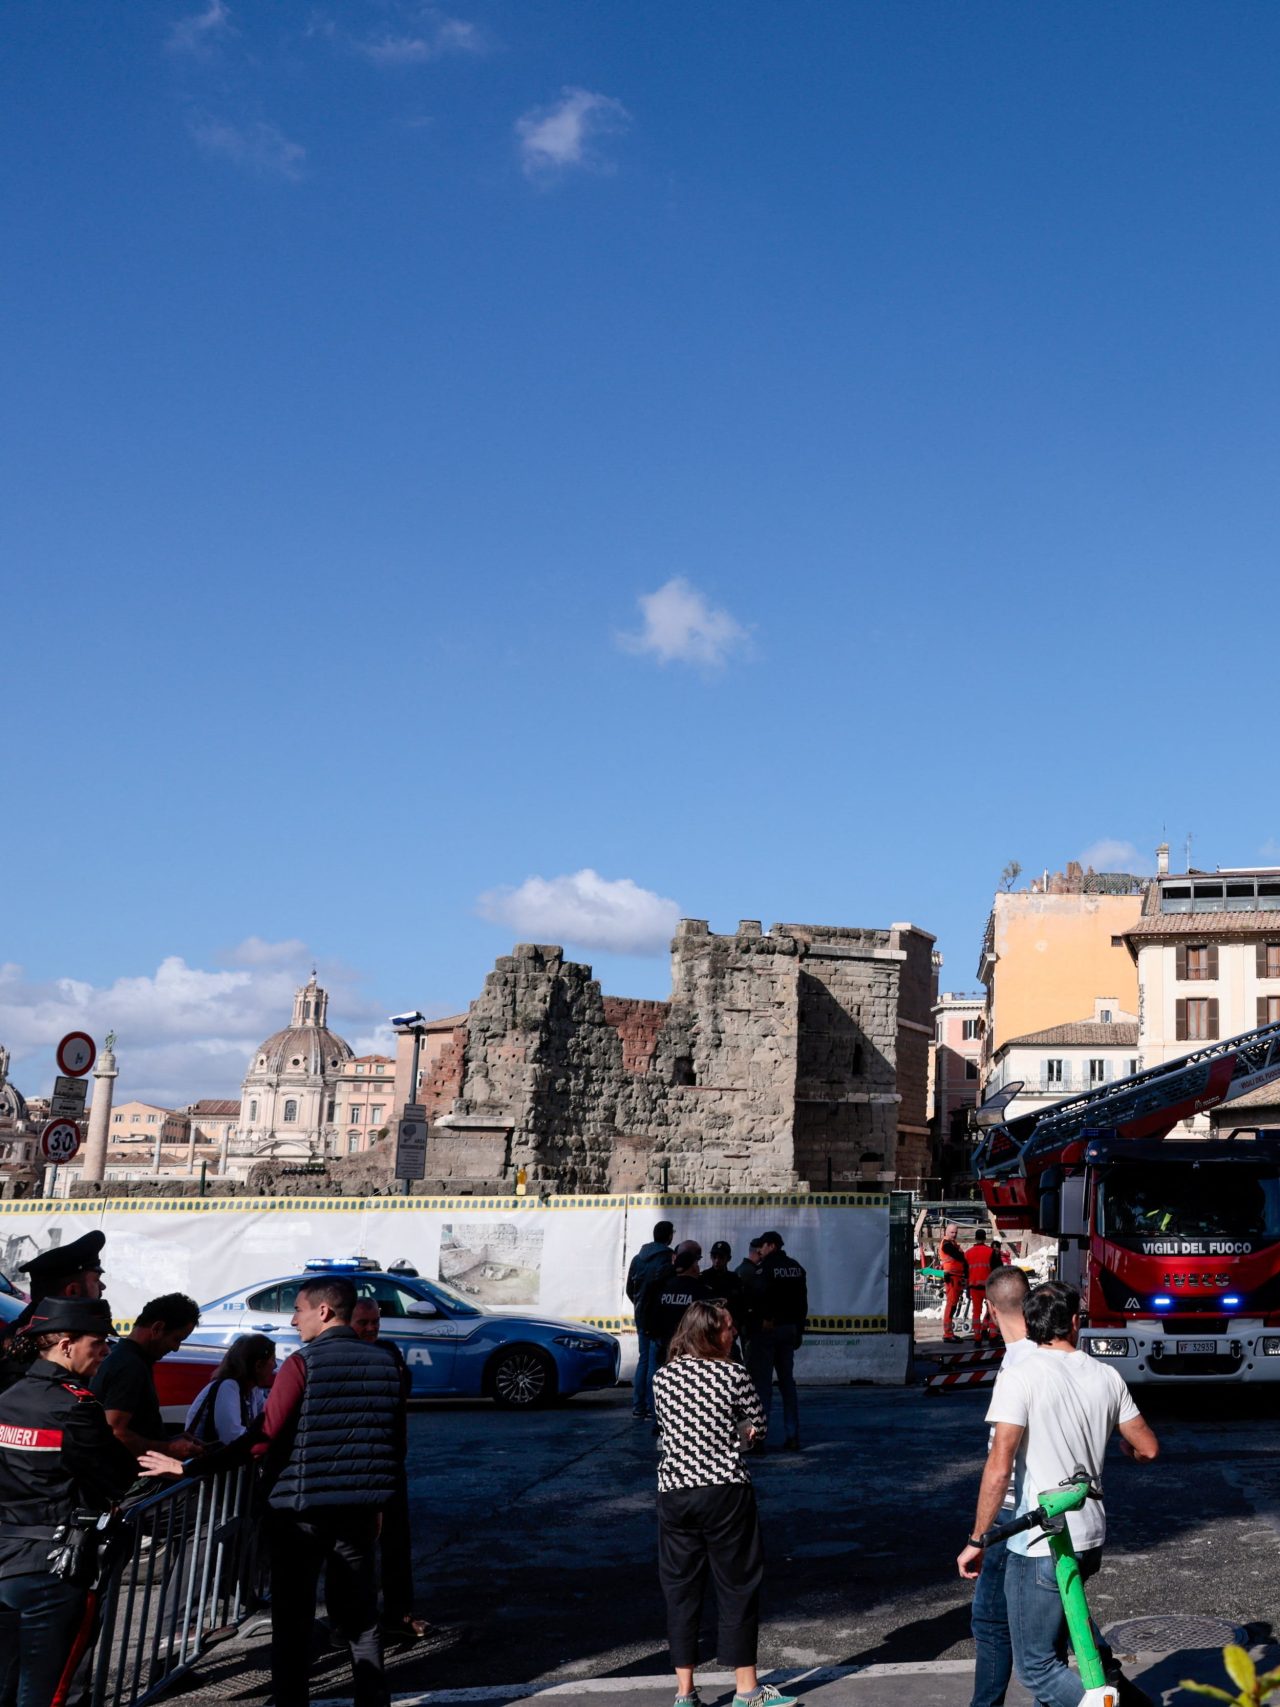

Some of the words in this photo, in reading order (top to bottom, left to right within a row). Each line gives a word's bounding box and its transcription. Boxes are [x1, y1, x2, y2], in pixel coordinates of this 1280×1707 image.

[51, 1130, 73, 1152] 30
[1142, 1242, 1178, 1254] VIGILI
[1181, 1242, 1206, 1254] DEL
[1209, 1242, 1252, 1254] FUOCO
[1163, 1273, 1231, 1287] IVECO
[661, 1293, 693, 1305] POLIZIA
[223, 1302, 245, 1310] 113
[1192, 1341, 1215, 1352] 32935
